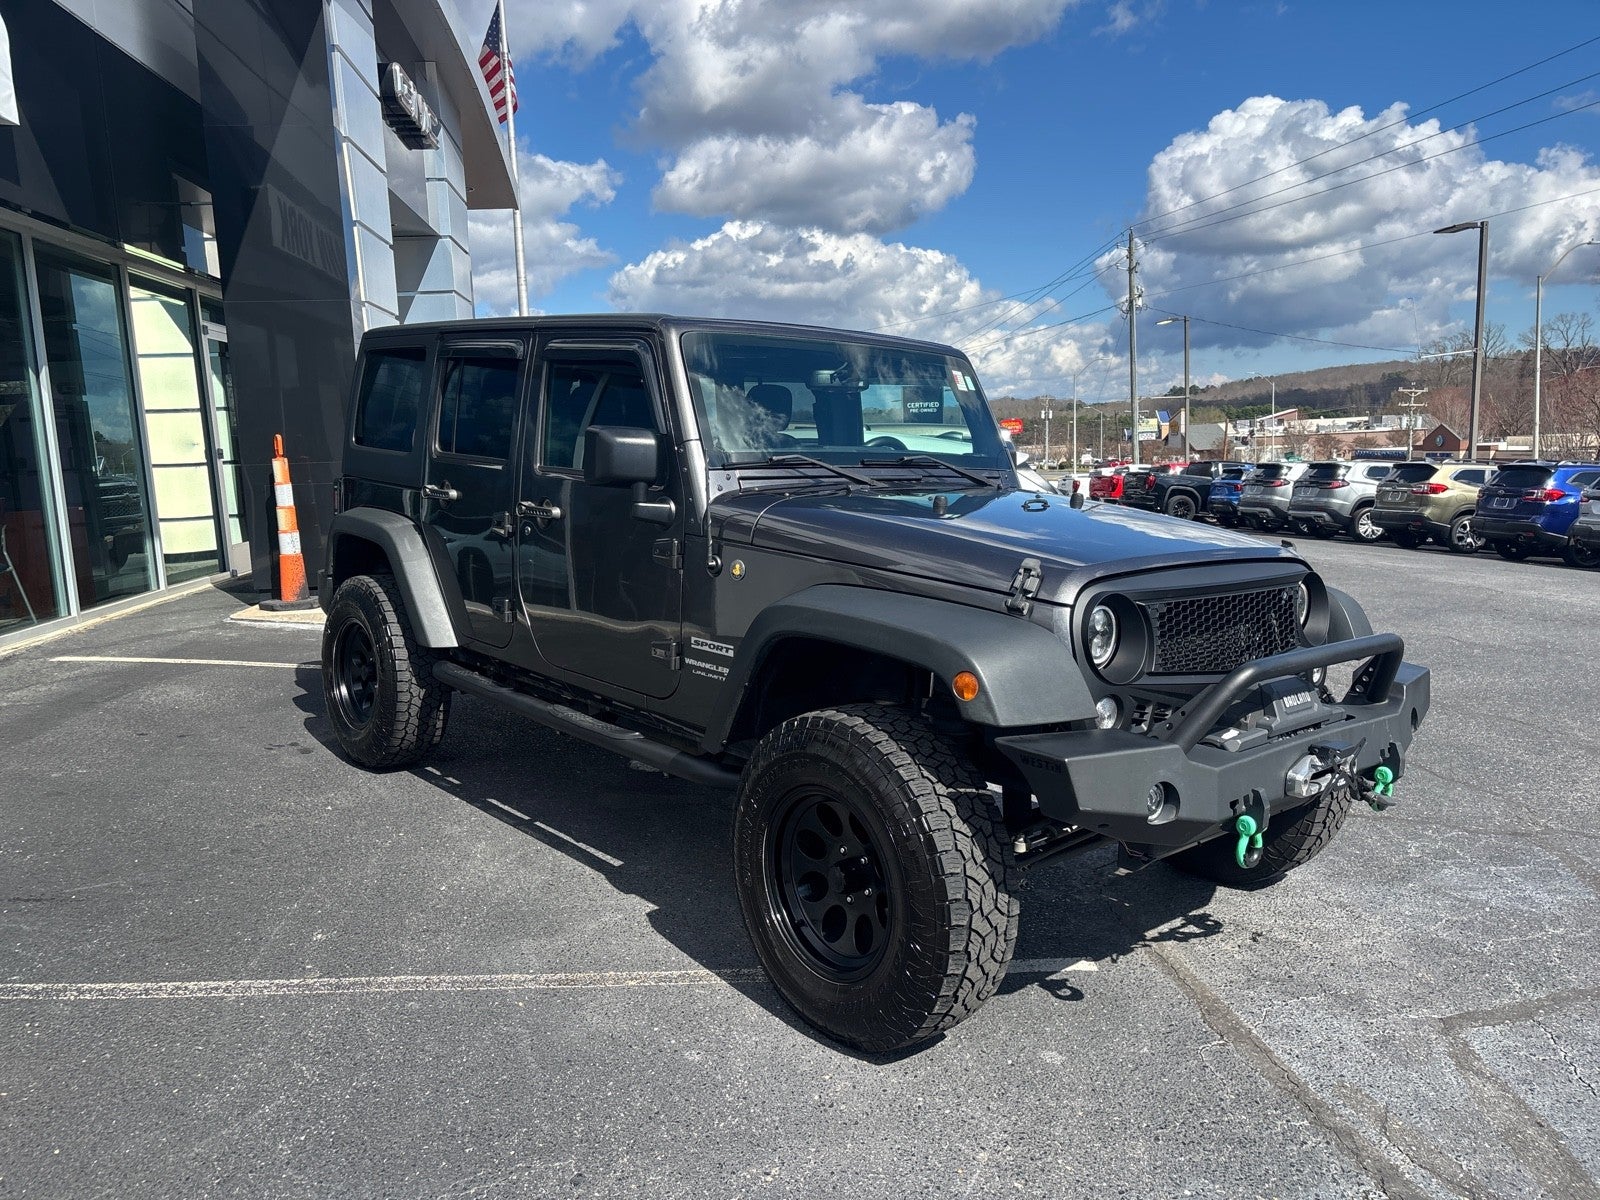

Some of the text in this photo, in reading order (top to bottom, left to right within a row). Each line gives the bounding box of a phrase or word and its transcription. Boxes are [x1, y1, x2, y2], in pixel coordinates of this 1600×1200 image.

[907, 401, 940, 409] CERTIFIED
[692, 639, 733, 654] SPORT
[684, 657, 730, 674] WRANGLER
[1283, 691, 1311, 708] BADLAND
